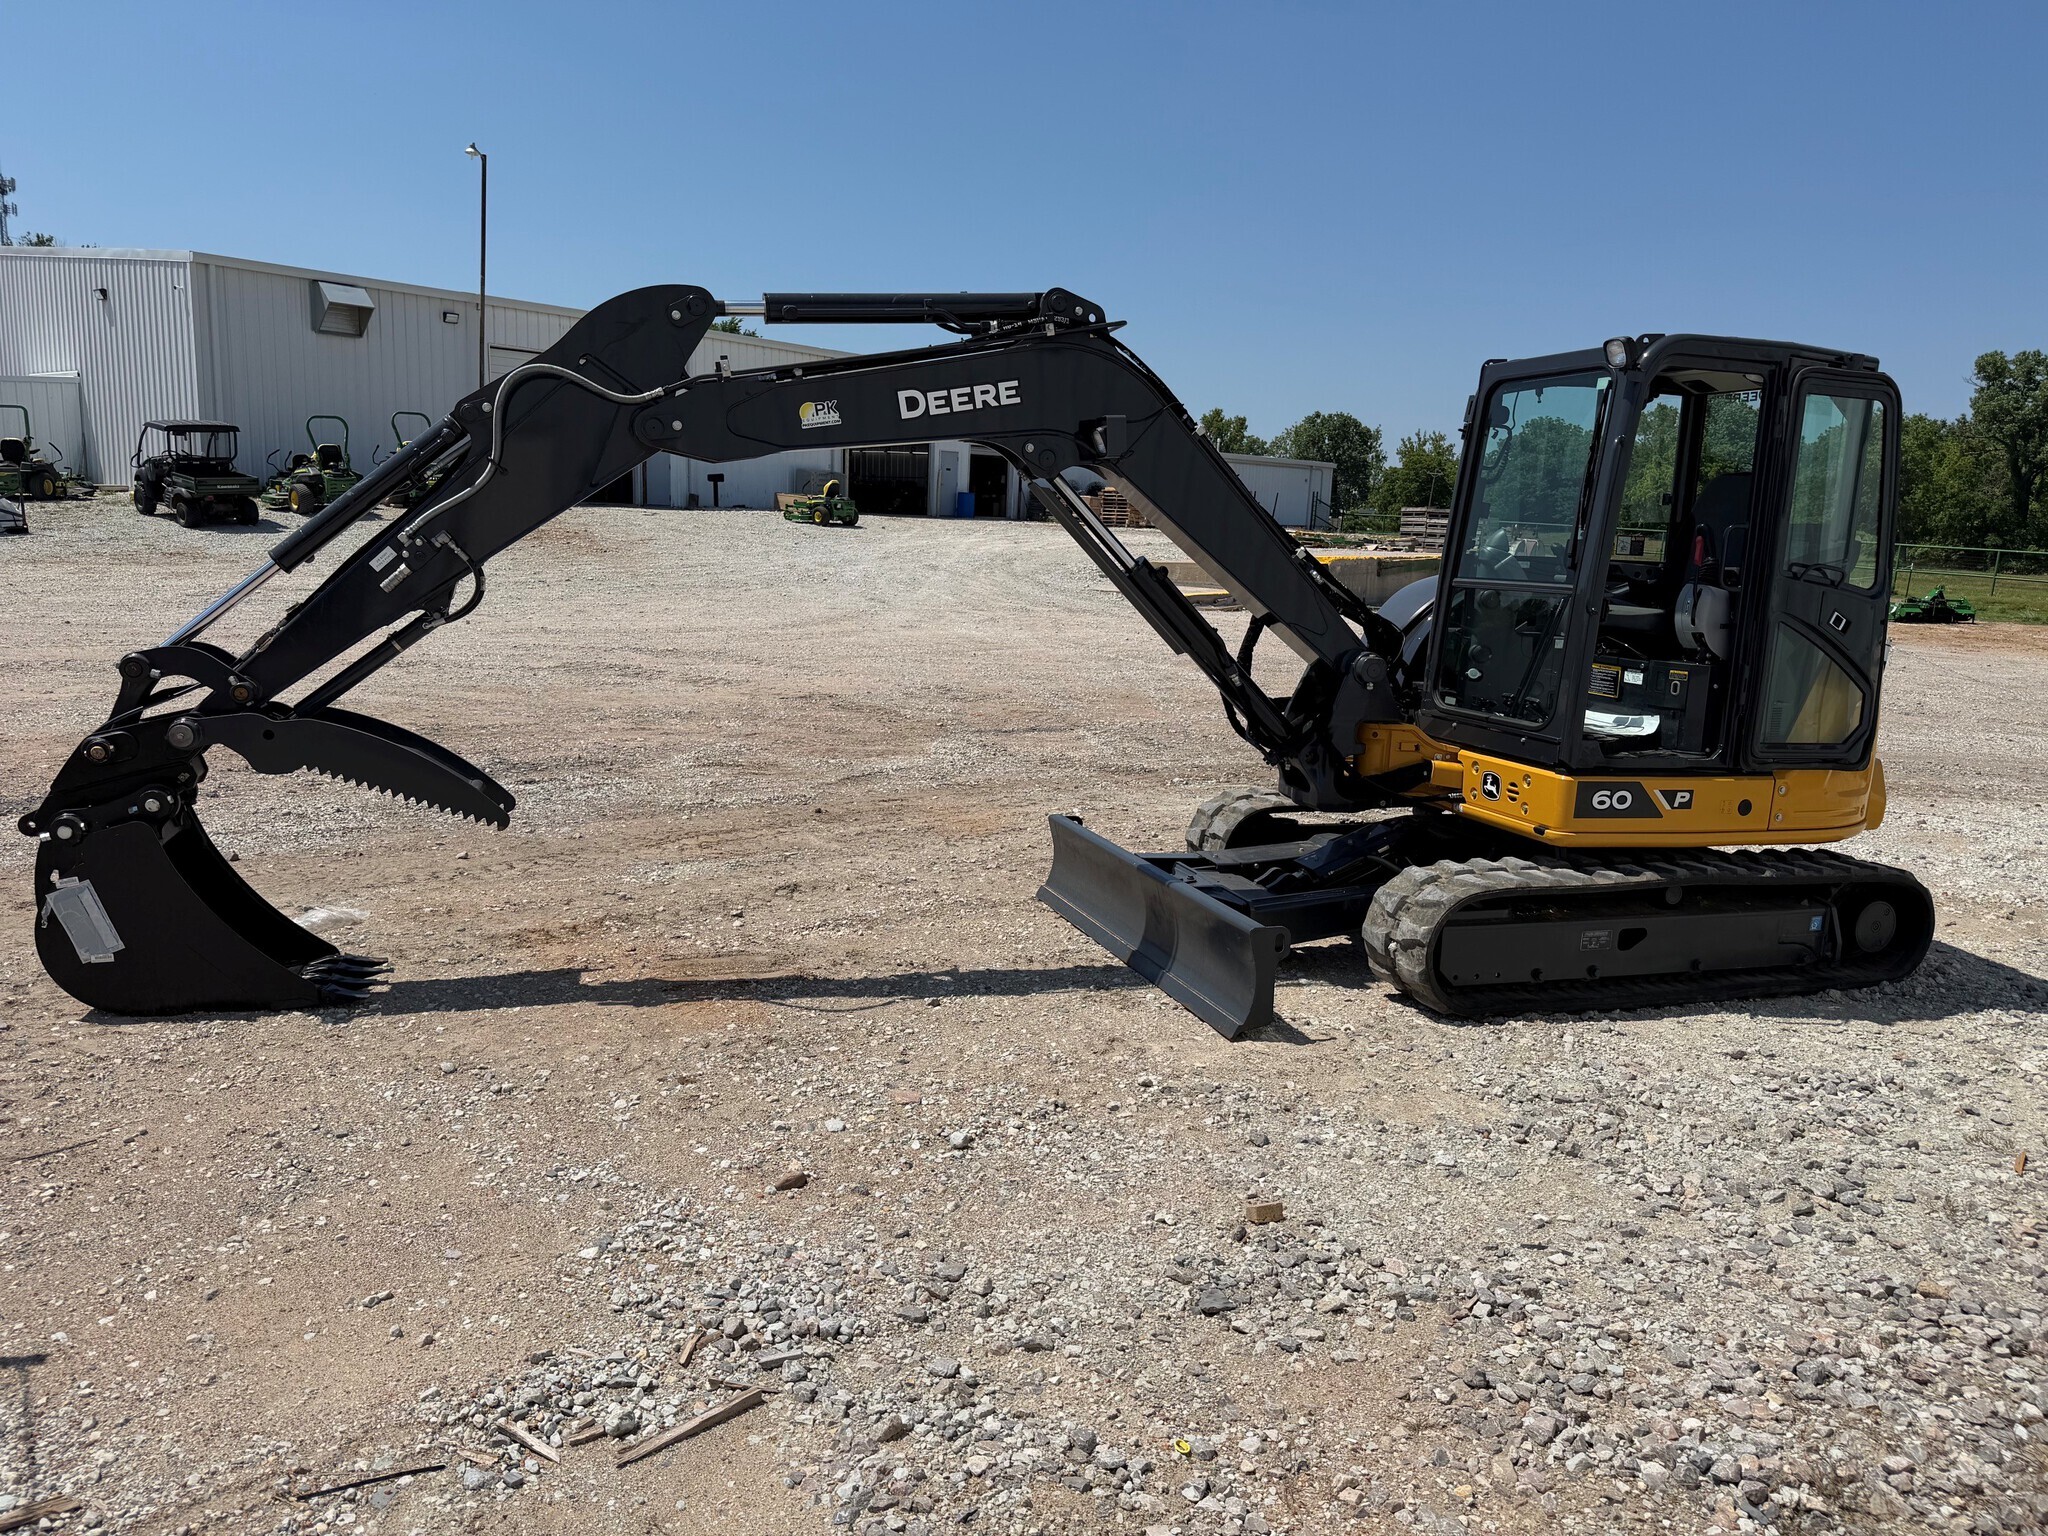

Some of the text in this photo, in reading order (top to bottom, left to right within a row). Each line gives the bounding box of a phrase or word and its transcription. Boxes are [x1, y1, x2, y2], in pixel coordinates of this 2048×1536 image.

[897, 380, 1021, 419] DEERE
[1591, 790, 1691, 810] 60 P
